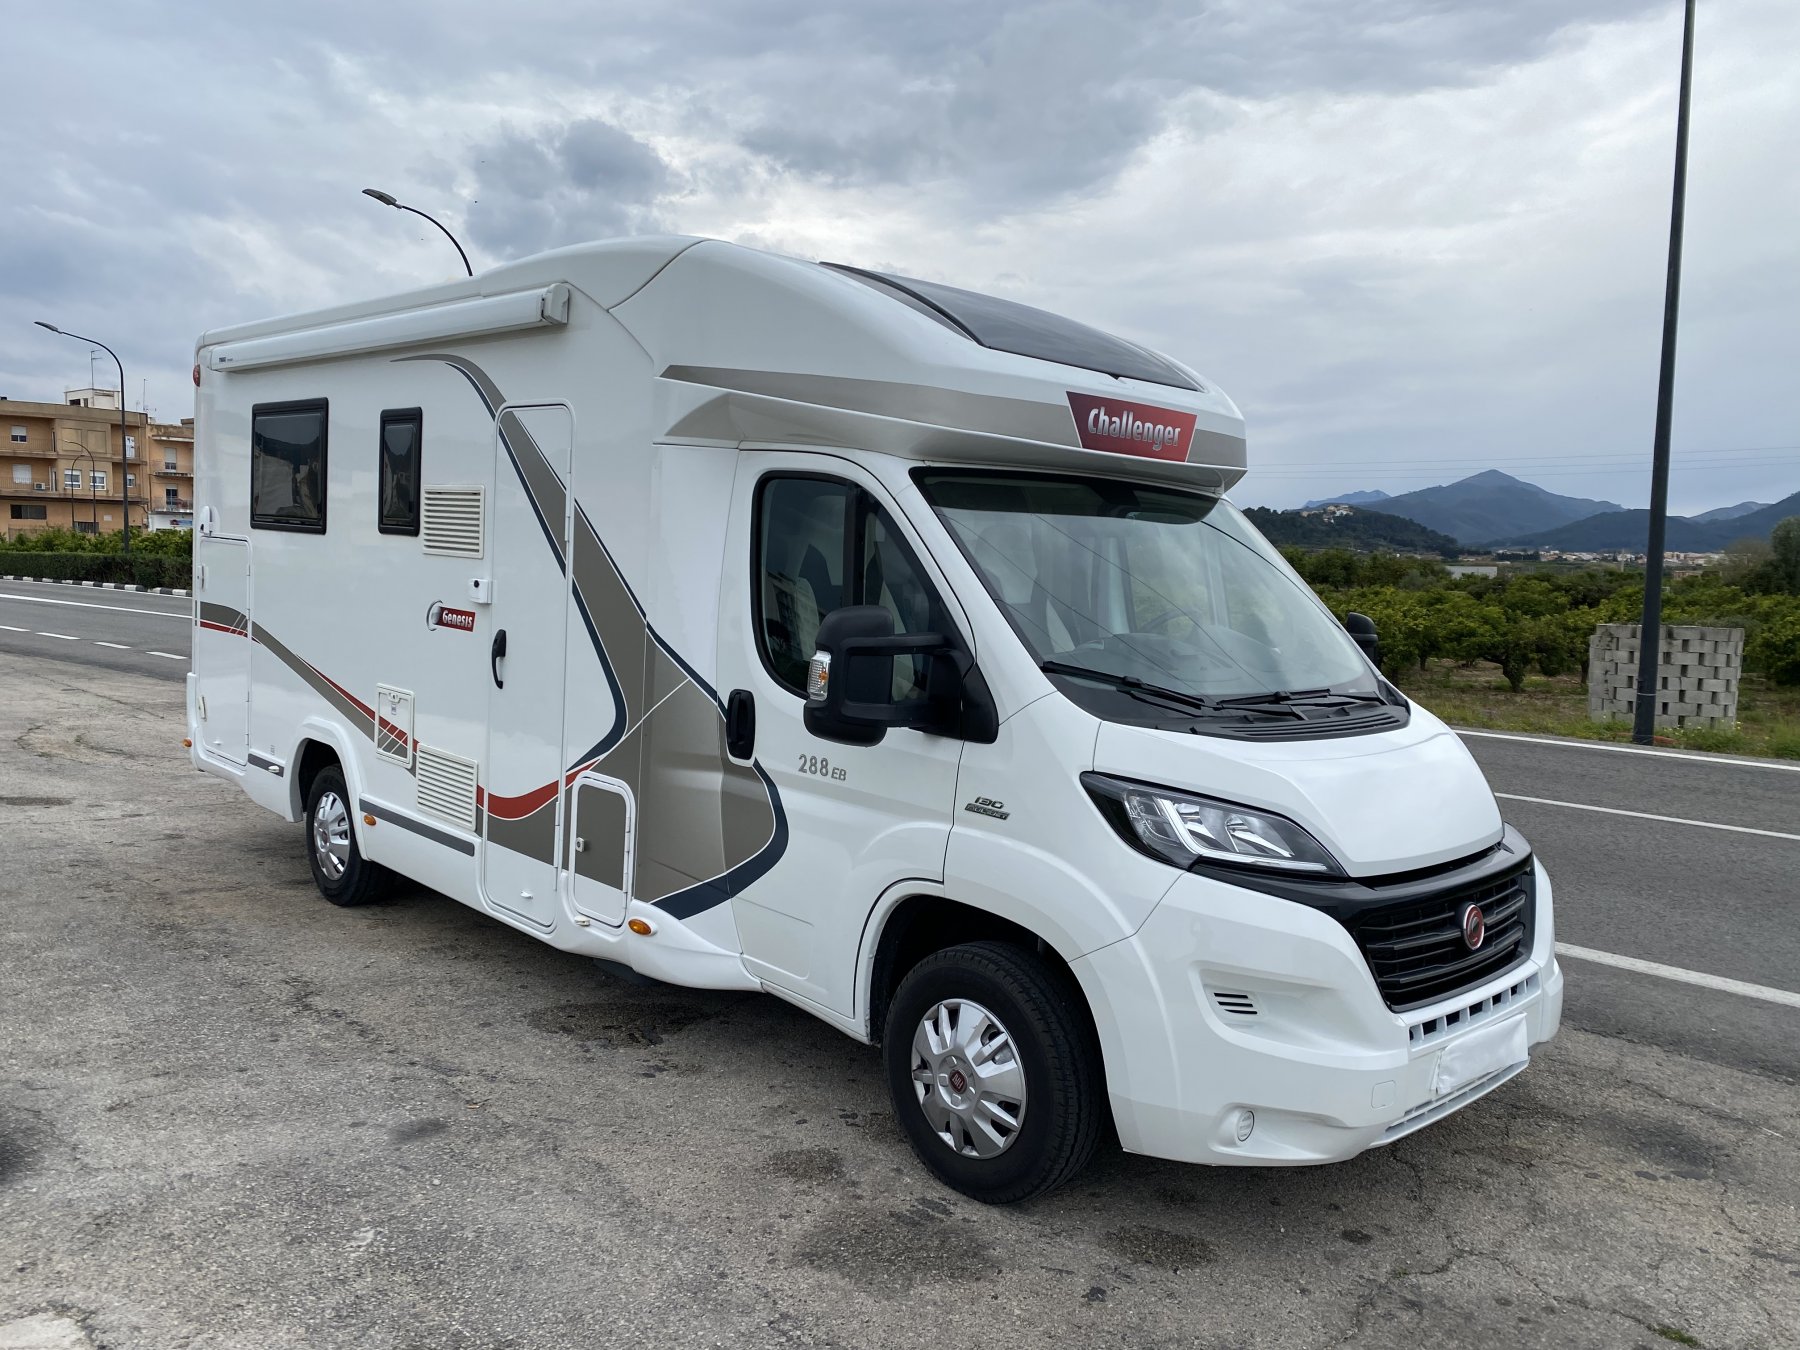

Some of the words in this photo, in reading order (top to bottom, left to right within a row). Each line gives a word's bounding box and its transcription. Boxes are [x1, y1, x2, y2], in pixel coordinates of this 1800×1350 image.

[1087, 406, 1181, 451] Challenger
[442, 610, 473, 628] Genesis
[798, 753, 829, 777] 288
[831, 766, 847, 781] EB
